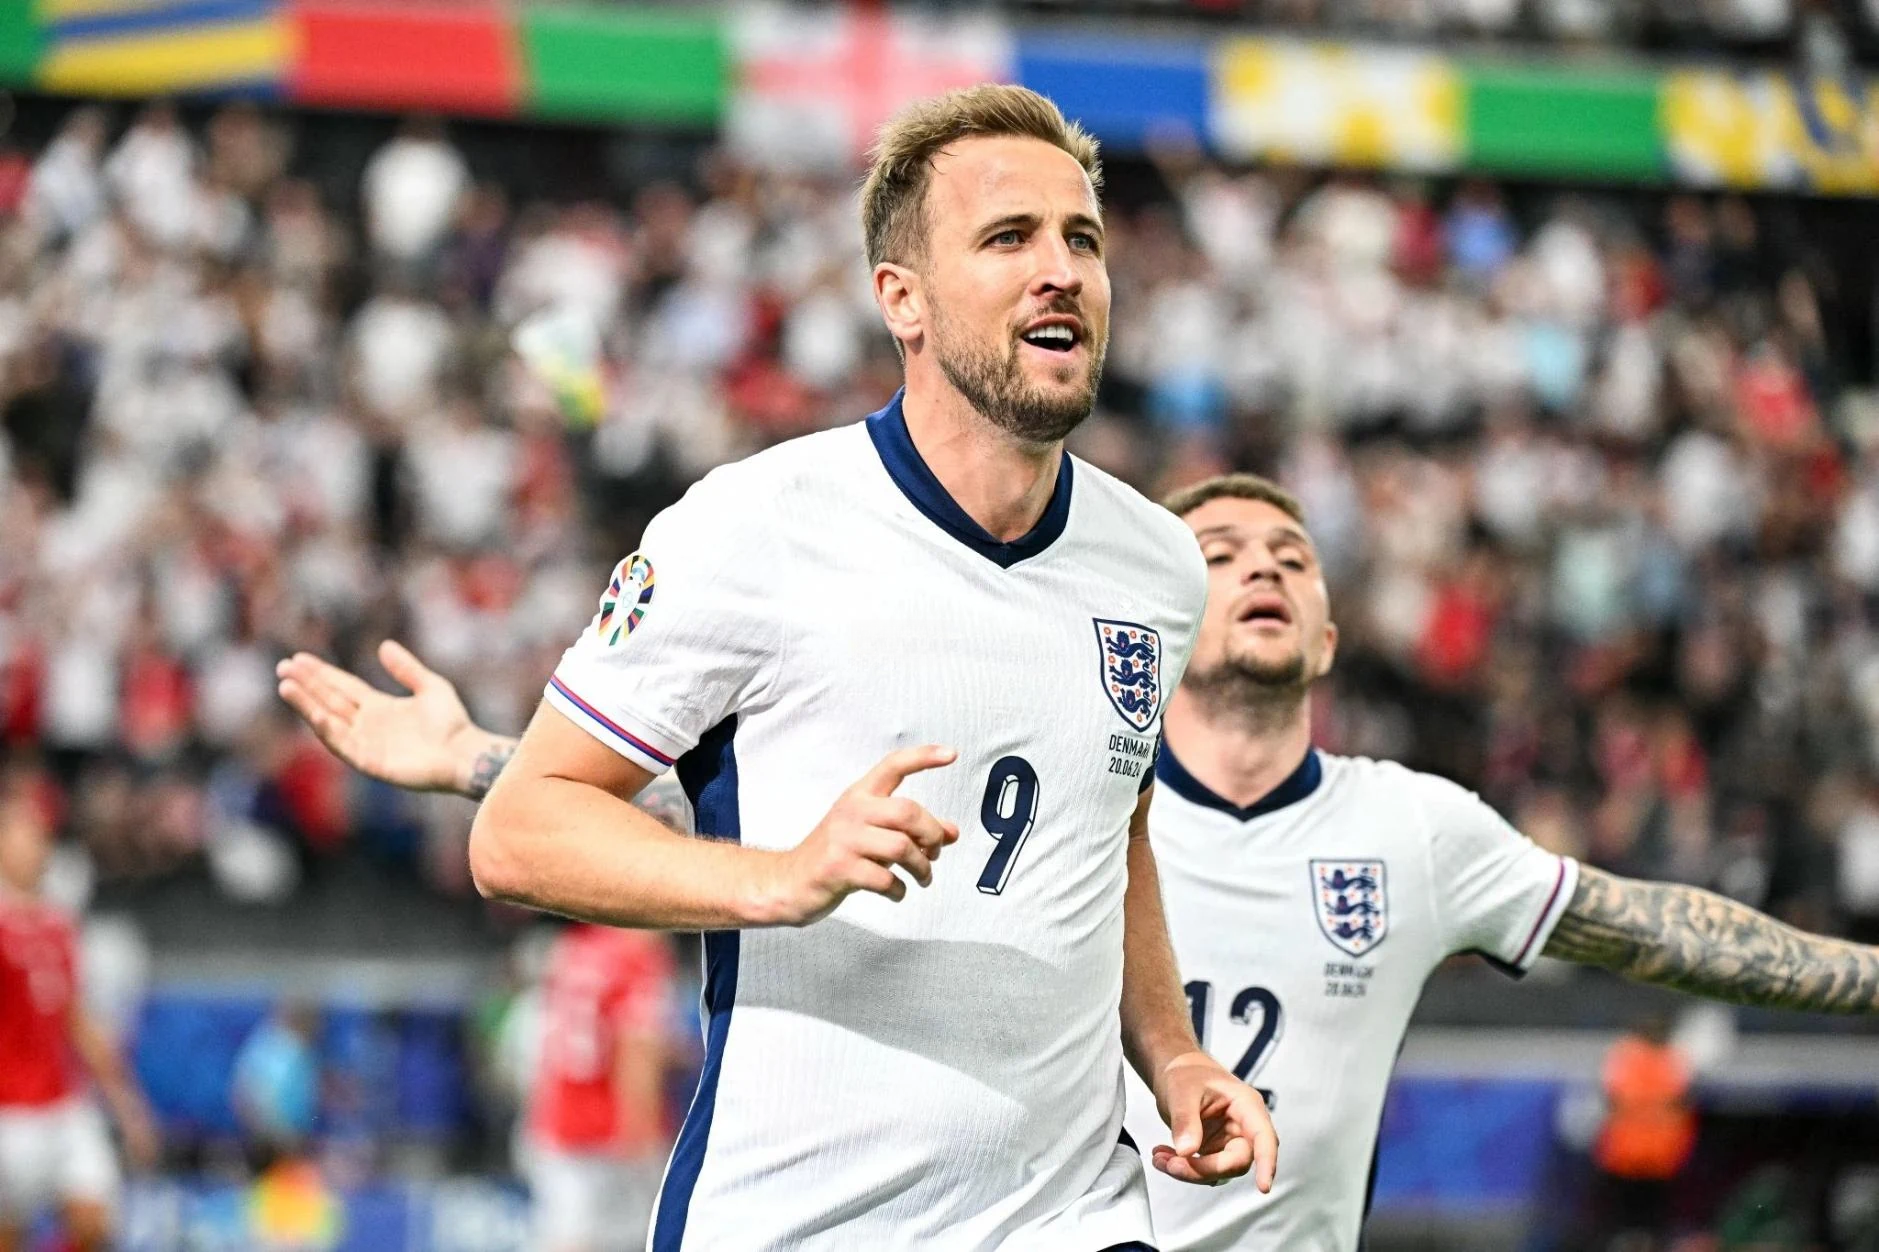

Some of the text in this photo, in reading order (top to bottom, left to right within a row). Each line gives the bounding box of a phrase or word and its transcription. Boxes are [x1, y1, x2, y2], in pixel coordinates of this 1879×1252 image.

[1109, 734, 1151, 759] DENMAR
[976, 755, 1040, 896] 9
[1184, 980, 1286, 1112] 12
